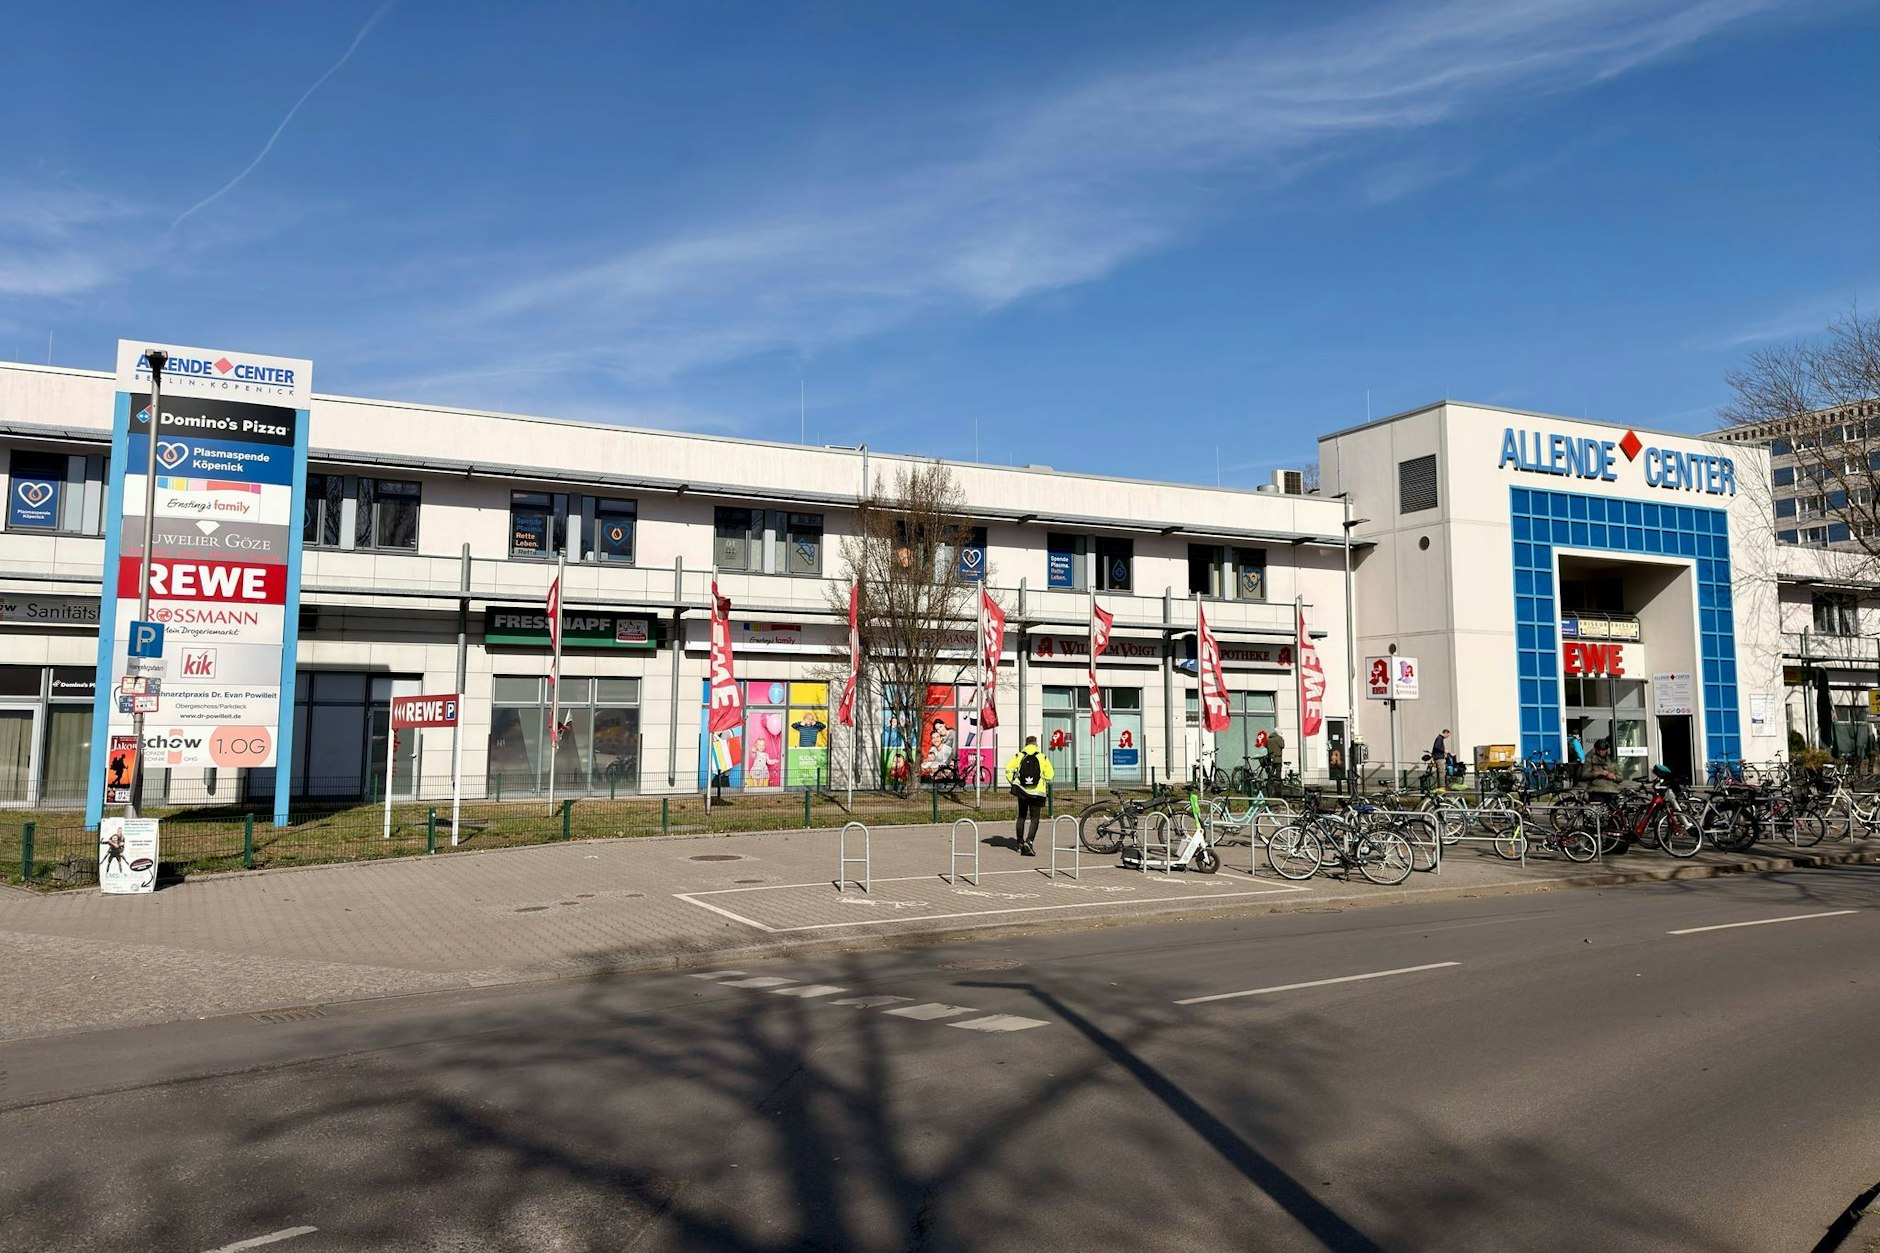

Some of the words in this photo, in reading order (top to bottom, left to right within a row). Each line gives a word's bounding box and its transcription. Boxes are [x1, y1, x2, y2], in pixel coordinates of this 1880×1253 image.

[136, 354, 212, 375] AENDE
[234, 364, 294, 383] CENTER
[135, 374, 294, 396] BELIN-KÖPENICK
[242, 419, 287, 436] Pizza
[193, 447, 270, 463] Plasmaspende
[1499, 428, 1618, 482] ALLENDE
[1644, 447, 1736, 496] CENTER
[192, 459, 244, 473] Köpenick
[166, 498, 212, 513] Ernsting's
[213, 499, 250, 514] family
[151, 534, 221, 547] UWELIER
[225, 533, 271, 550] GÖZE
[515, 532, 536, 540] Rette
[139, 562, 267, 600] REWE
[147, 608, 258, 625] ROSSMANN
[136, 626, 156, 653] P
[180, 625, 240, 638] Drogeriemarkt
[775, 636, 796, 645] family
[1059, 640, 1119, 657] WILLM
[1119, 643, 1156, 658] VOIGT
[183, 651, 213, 675] kik
[1220, 649, 1270, 661] POTHEKE
[1563, 643, 1625, 676] EWE
[159, 691, 210, 699] hnarztpraxis
[406, 701, 444, 722] REWE
[447, 703, 455, 718] P
